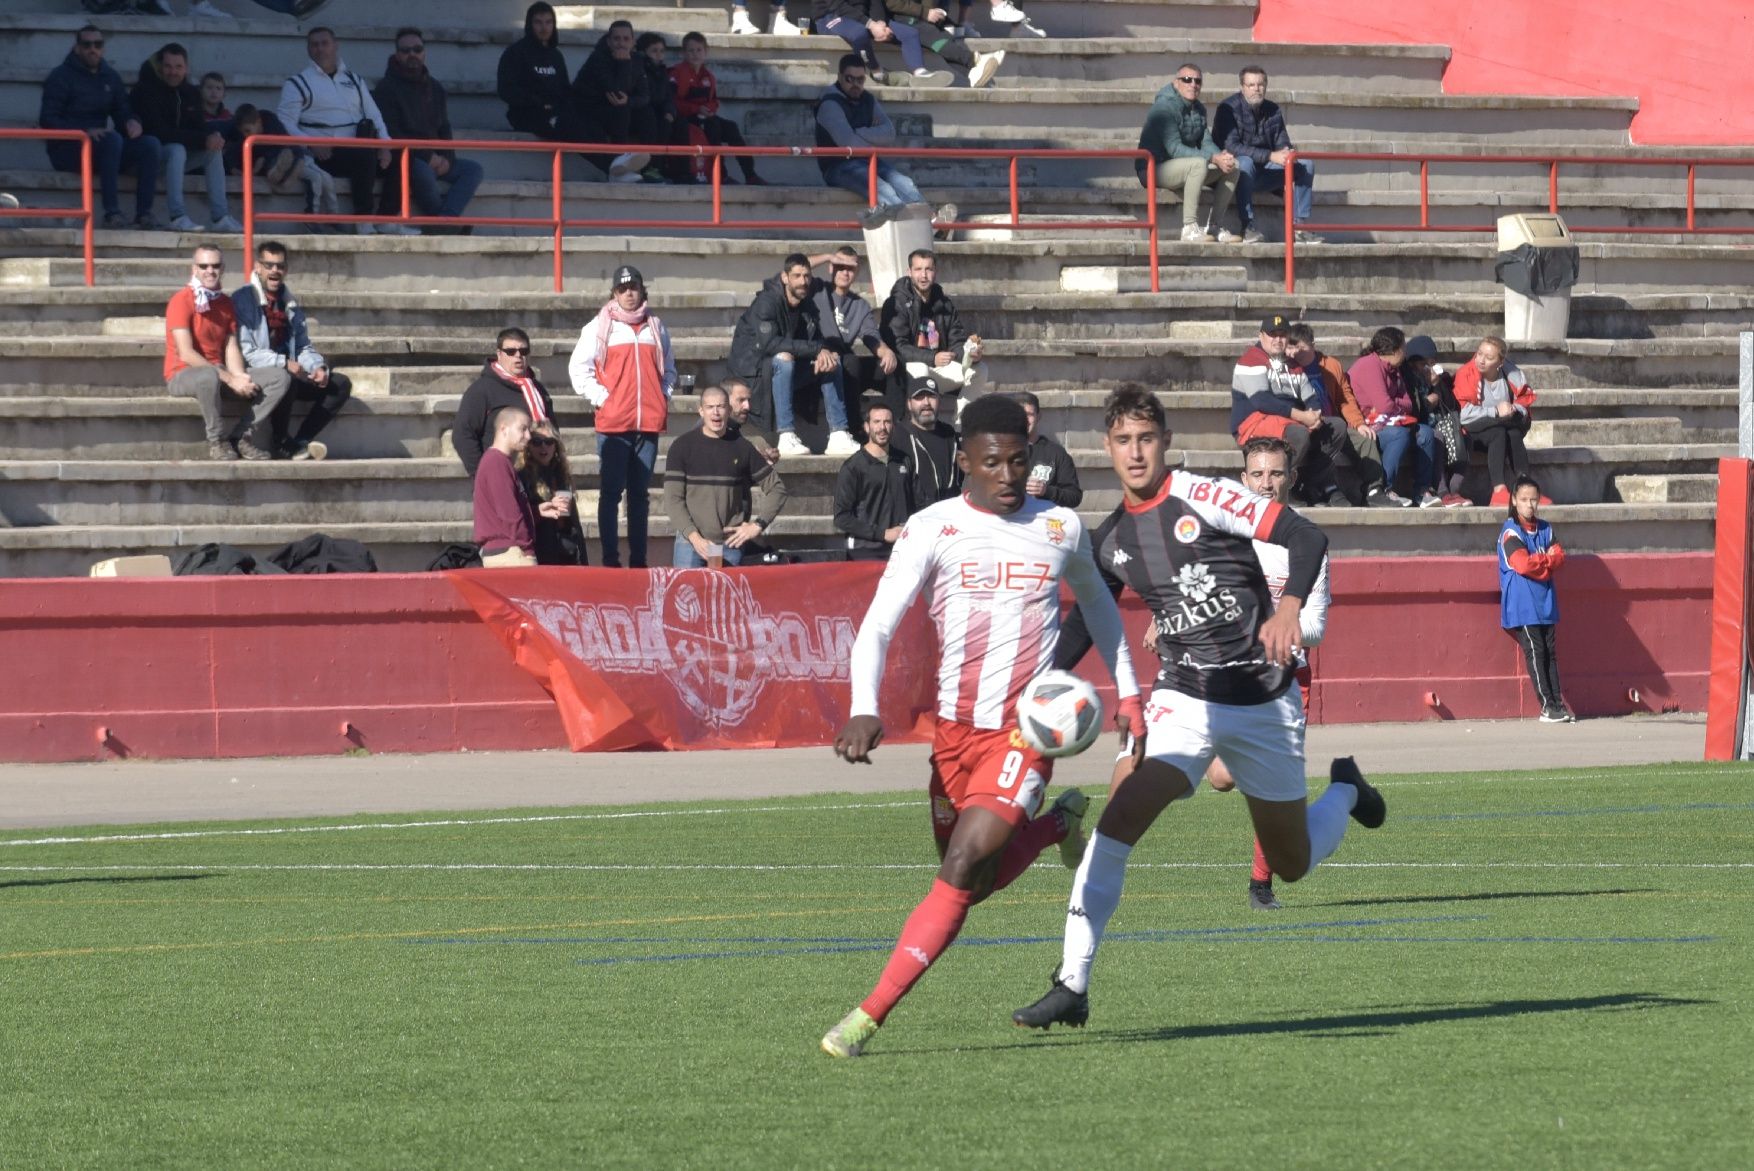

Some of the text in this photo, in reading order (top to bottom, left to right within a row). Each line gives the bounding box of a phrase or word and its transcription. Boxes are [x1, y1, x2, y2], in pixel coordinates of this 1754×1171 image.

[1187, 482, 1256, 526] IBIZA
[961, 562, 1055, 592] EJE7
[997, 750, 1024, 789] 9
